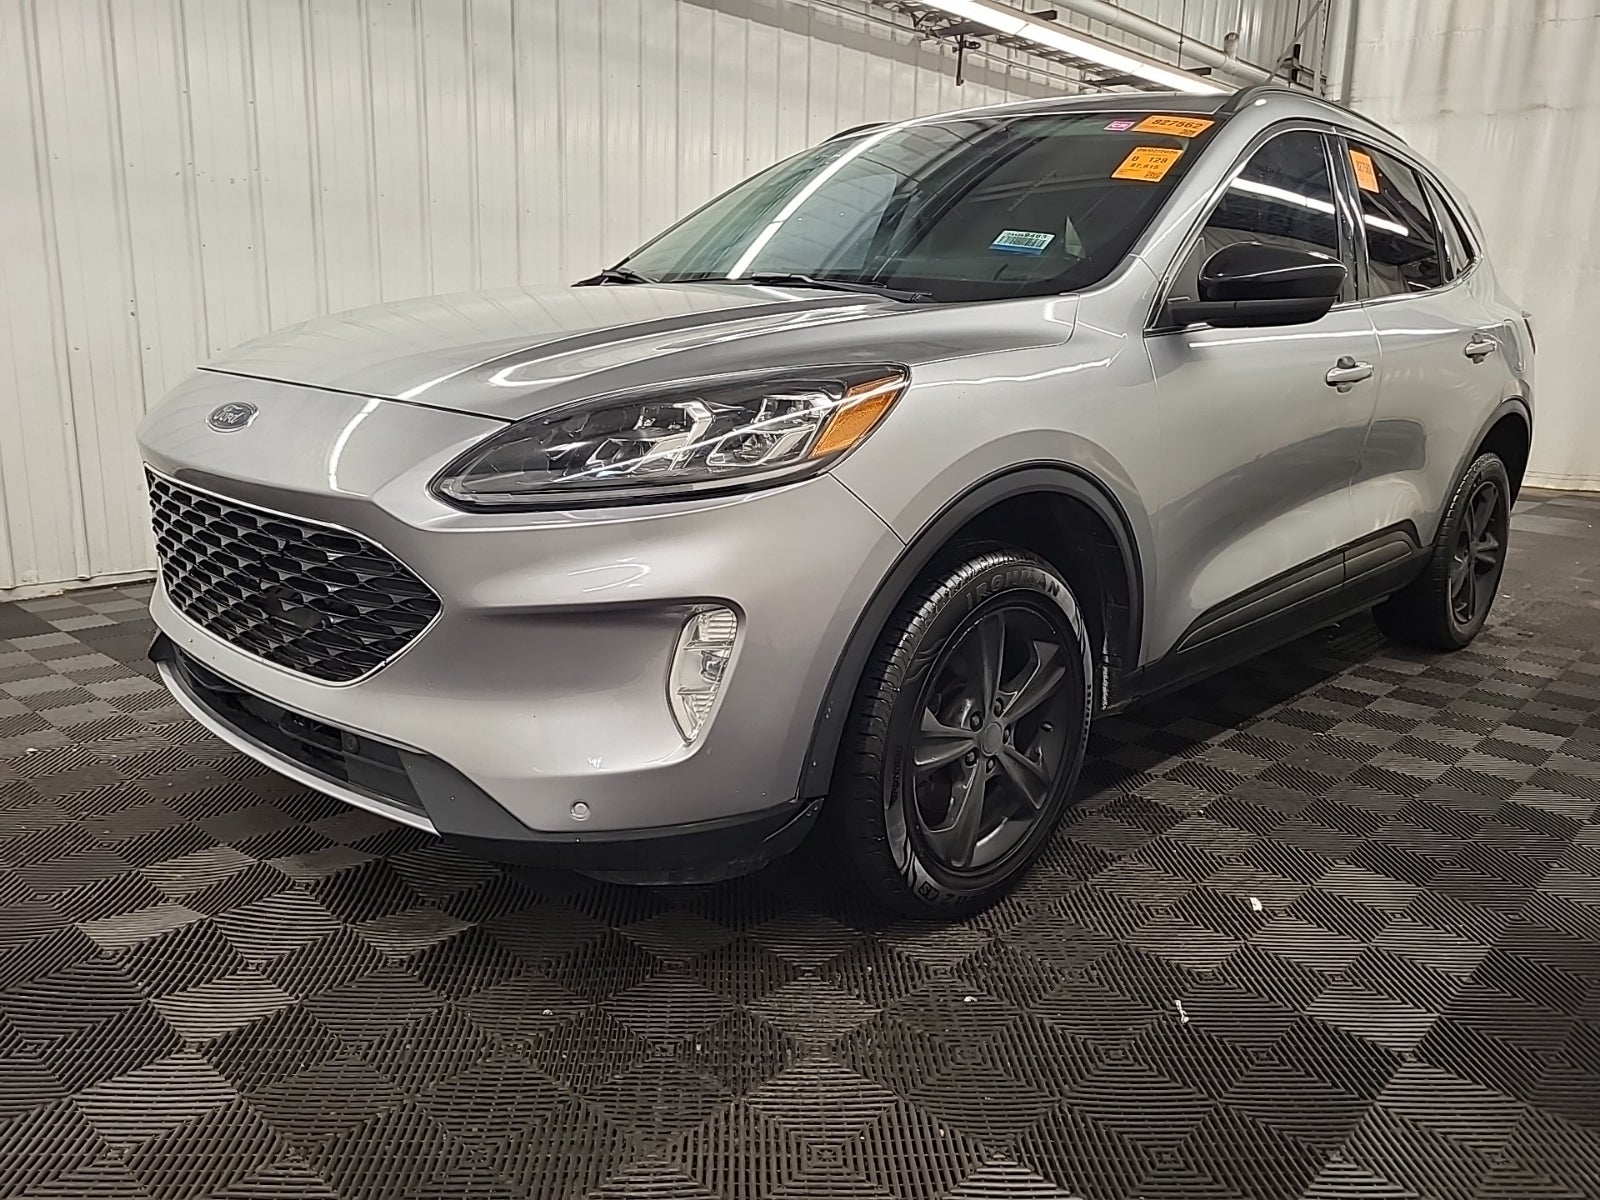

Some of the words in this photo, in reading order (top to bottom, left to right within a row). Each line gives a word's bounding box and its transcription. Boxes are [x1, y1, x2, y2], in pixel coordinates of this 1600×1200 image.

[1151, 118, 1204, 129] 827562
[213, 404, 245, 424] Ford
[966, 568, 1061, 611] IRONMAN
